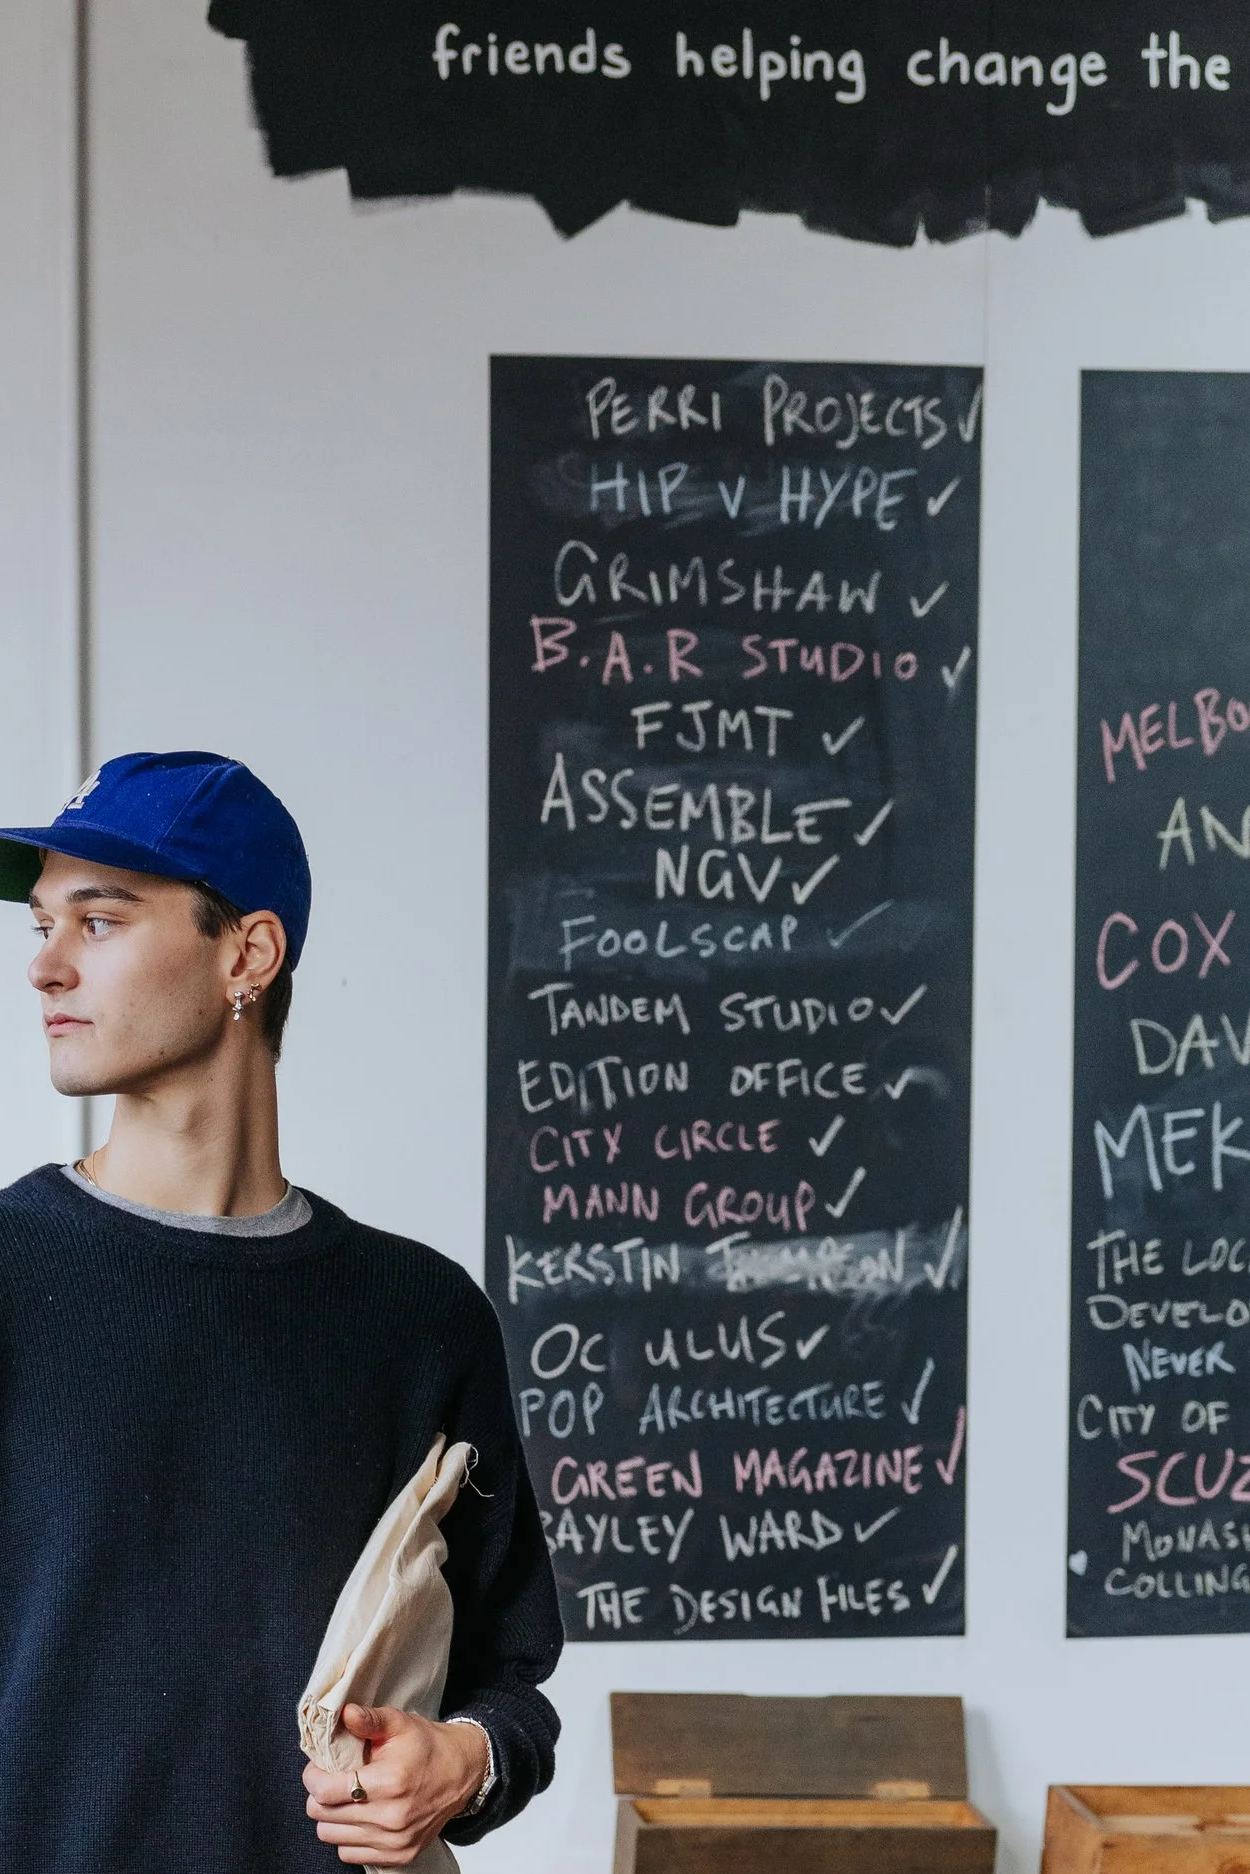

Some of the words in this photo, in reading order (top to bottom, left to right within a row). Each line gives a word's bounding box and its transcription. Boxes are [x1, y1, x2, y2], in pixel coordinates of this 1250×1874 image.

[432, 22, 631, 82] friends
[675, 27, 867, 104] helping
[907, 38, 1109, 117] change
[1141, 31, 1232, 92] the
[586, 377, 721, 439] PERRI
[763, 374, 947, 449] PROJECTS
[590, 462, 688, 517] HIP
[780, 466, 917, 530] HYPE
[555, 540, 881, 616] GRIMSHAW
[742, 634, 919, 681] STUDIO
[630, 700, 794, 756] FJMT
[541, 752, 851, 845] ASSEMBLE
[655, 844, 781, 903] NGV
[559, 914, 798, 972] FOOLSCAP
[1096, 908, 1236, 991] COX
[528, 982, 690, 1036] TANDEM
[719, 992, 873, 1034] STUDIO
[518, 1056, 688, 1113] EDITION
[730, 1058, 867, 1099] OFFICE
[529, 1122, 622, 1172] CITY
[655, 1118, 781, 1161] CIRCLE
[543, 1181, 659, 1225] MANN
[684, 1179, 816, 1231] GROUP
[505, 1234, 681, 1304] KERSTIN
[1086, 1229, 1165, 1290] THE
[1122, 1338, 1237, 1396] NEVER
[519, 1381, 604, 1437] POP
[638, 1380, 886, 1435] ARCHITECTURE
[1077, 1394, 1156, 1440] CITY
[1181, 1399, 1230, 1436] OF
[552, 1449, 703, 1504] GREEN
[733, 1444, 923, 1496] MAGAZINE
[720, 1509, 843, 1562] WARD
[576, 1580, 649, 1631] THE
[669, 1583, 802, 1636] DESIGN
[817, 1576, 910, 1624] FILES
